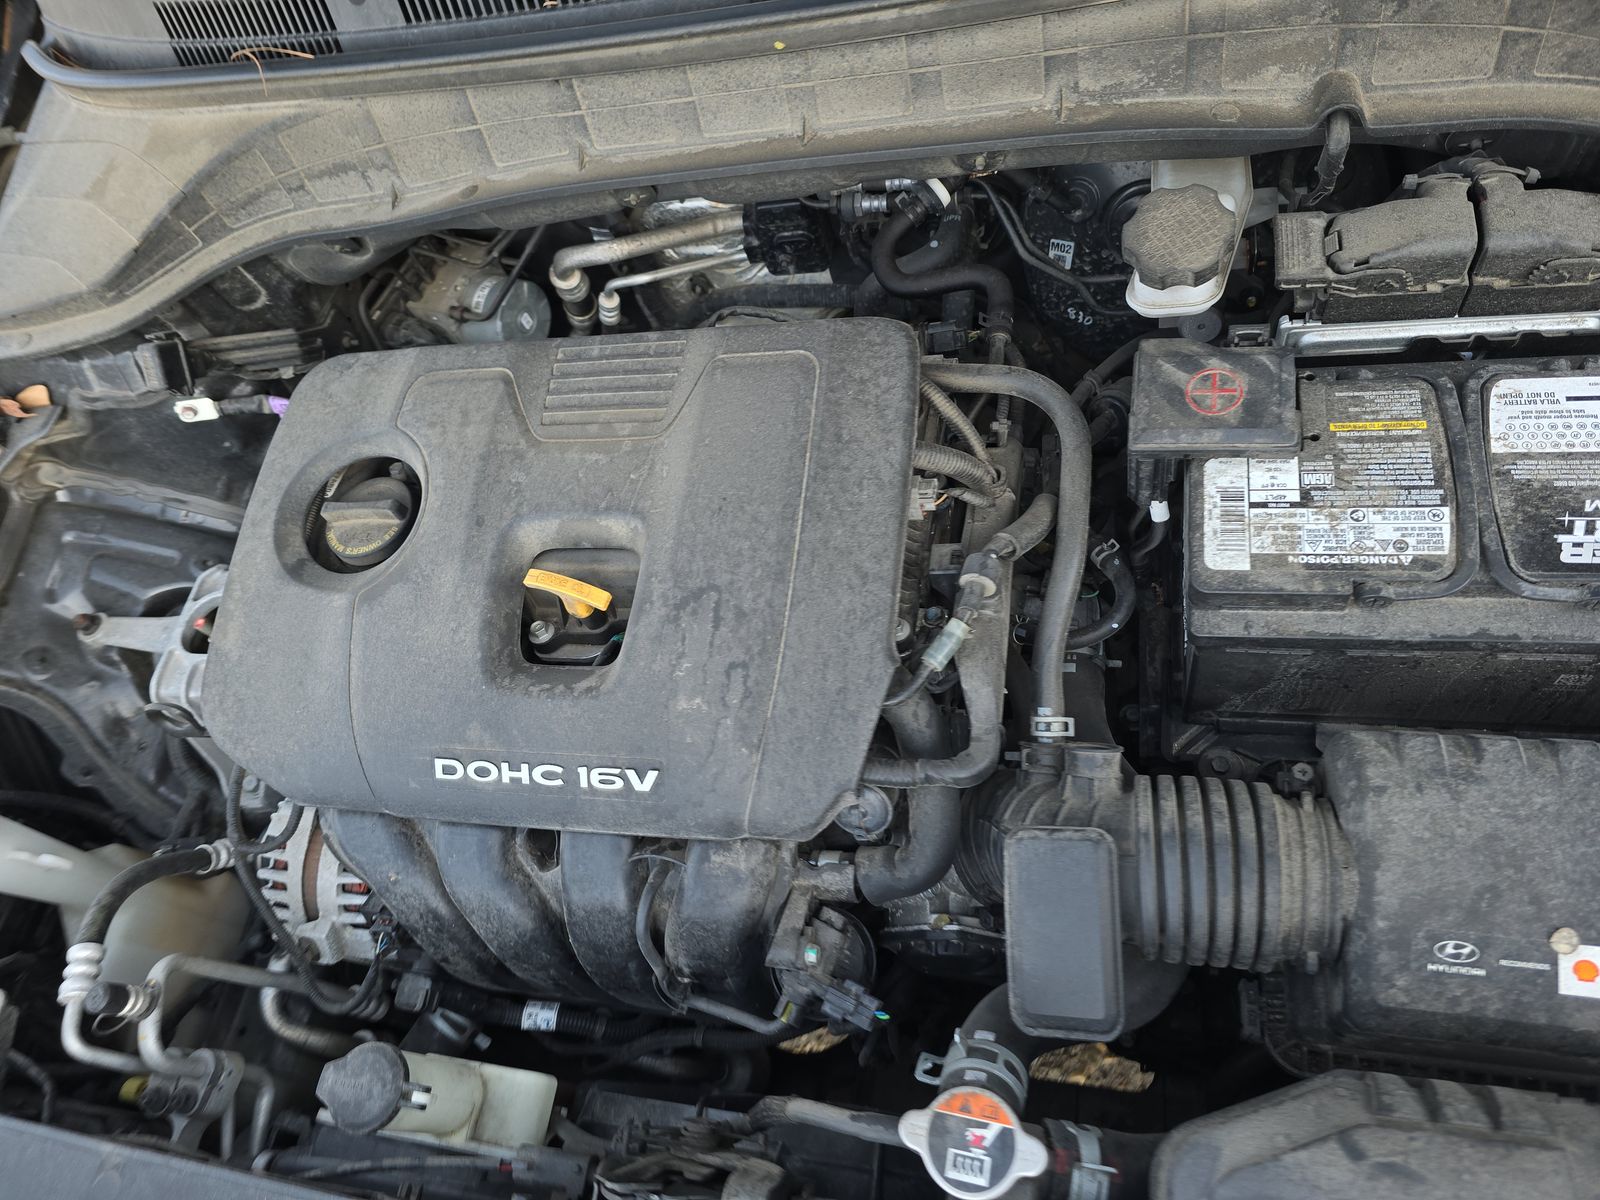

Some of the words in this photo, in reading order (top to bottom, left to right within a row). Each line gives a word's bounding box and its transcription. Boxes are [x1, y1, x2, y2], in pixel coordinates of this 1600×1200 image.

[1051, 241, 1072, 254] M02
[1303, 474, 1332, 484] AGM
[434, 757, 566, 786] DOHC
[577, 766, 660, 792] 16V
[1427, 963, 1486, 976] HYUNDAI
